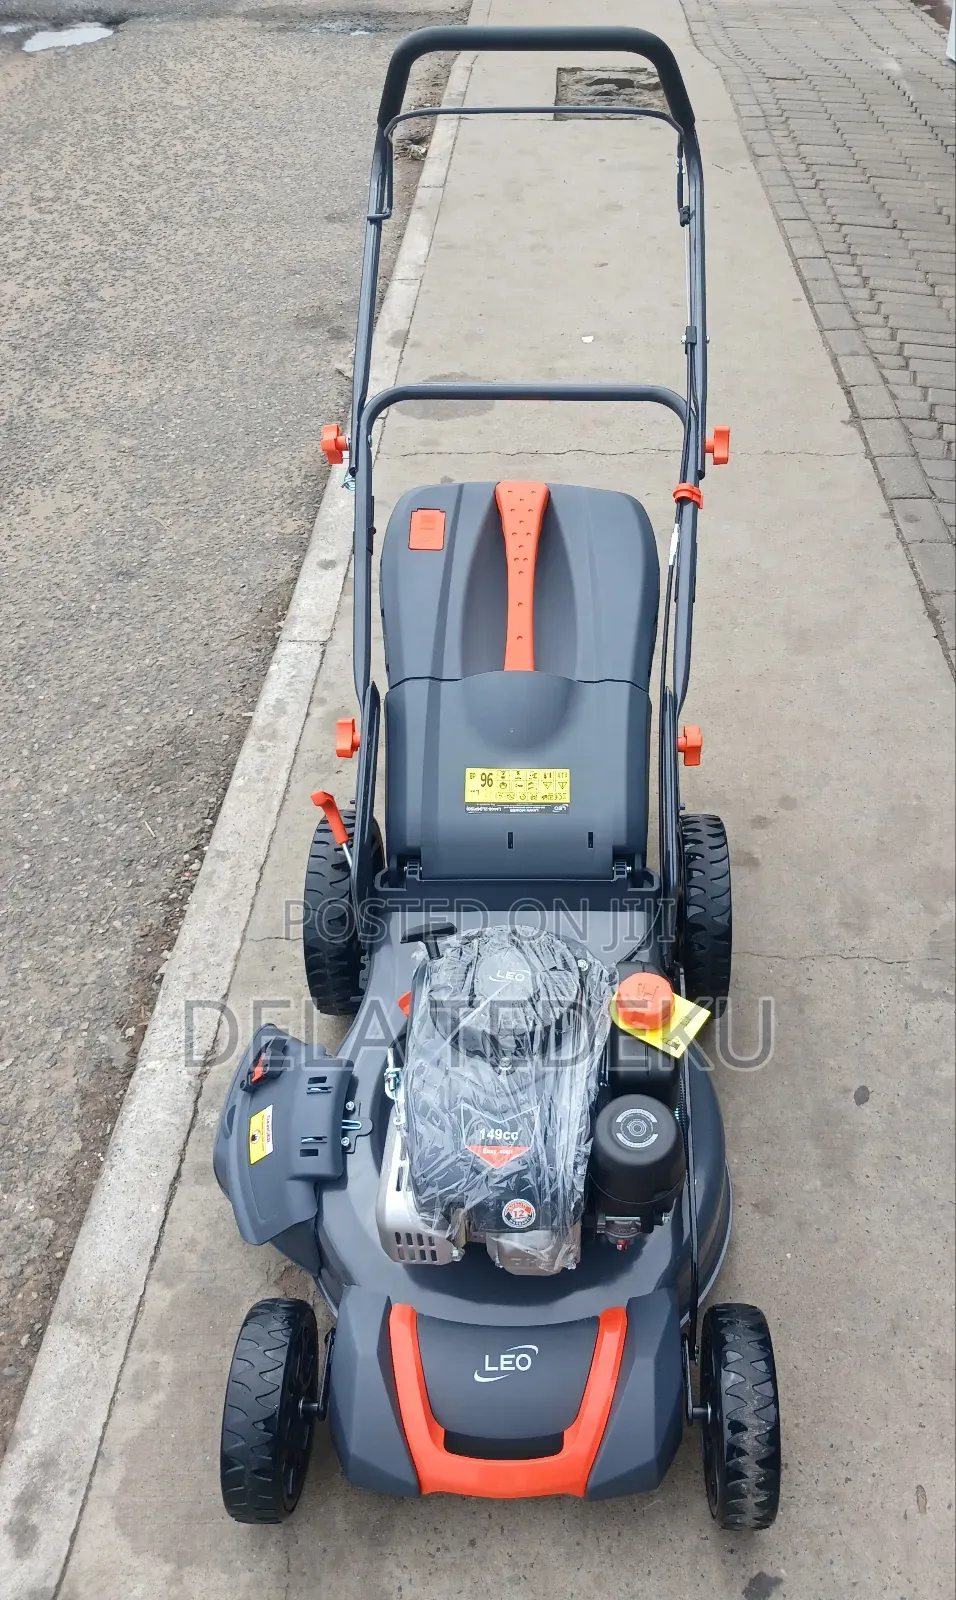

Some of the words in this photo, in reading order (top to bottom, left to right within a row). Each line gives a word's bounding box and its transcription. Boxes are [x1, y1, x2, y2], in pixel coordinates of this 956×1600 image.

[480, 772, 493, 788] 96
[496, 970, 526, 982] LEO
[479, 1128, 519, 1141] 149cc
[513, 1209, 525, 1218] 12
[484, 1353, 532, 1372] LEO
